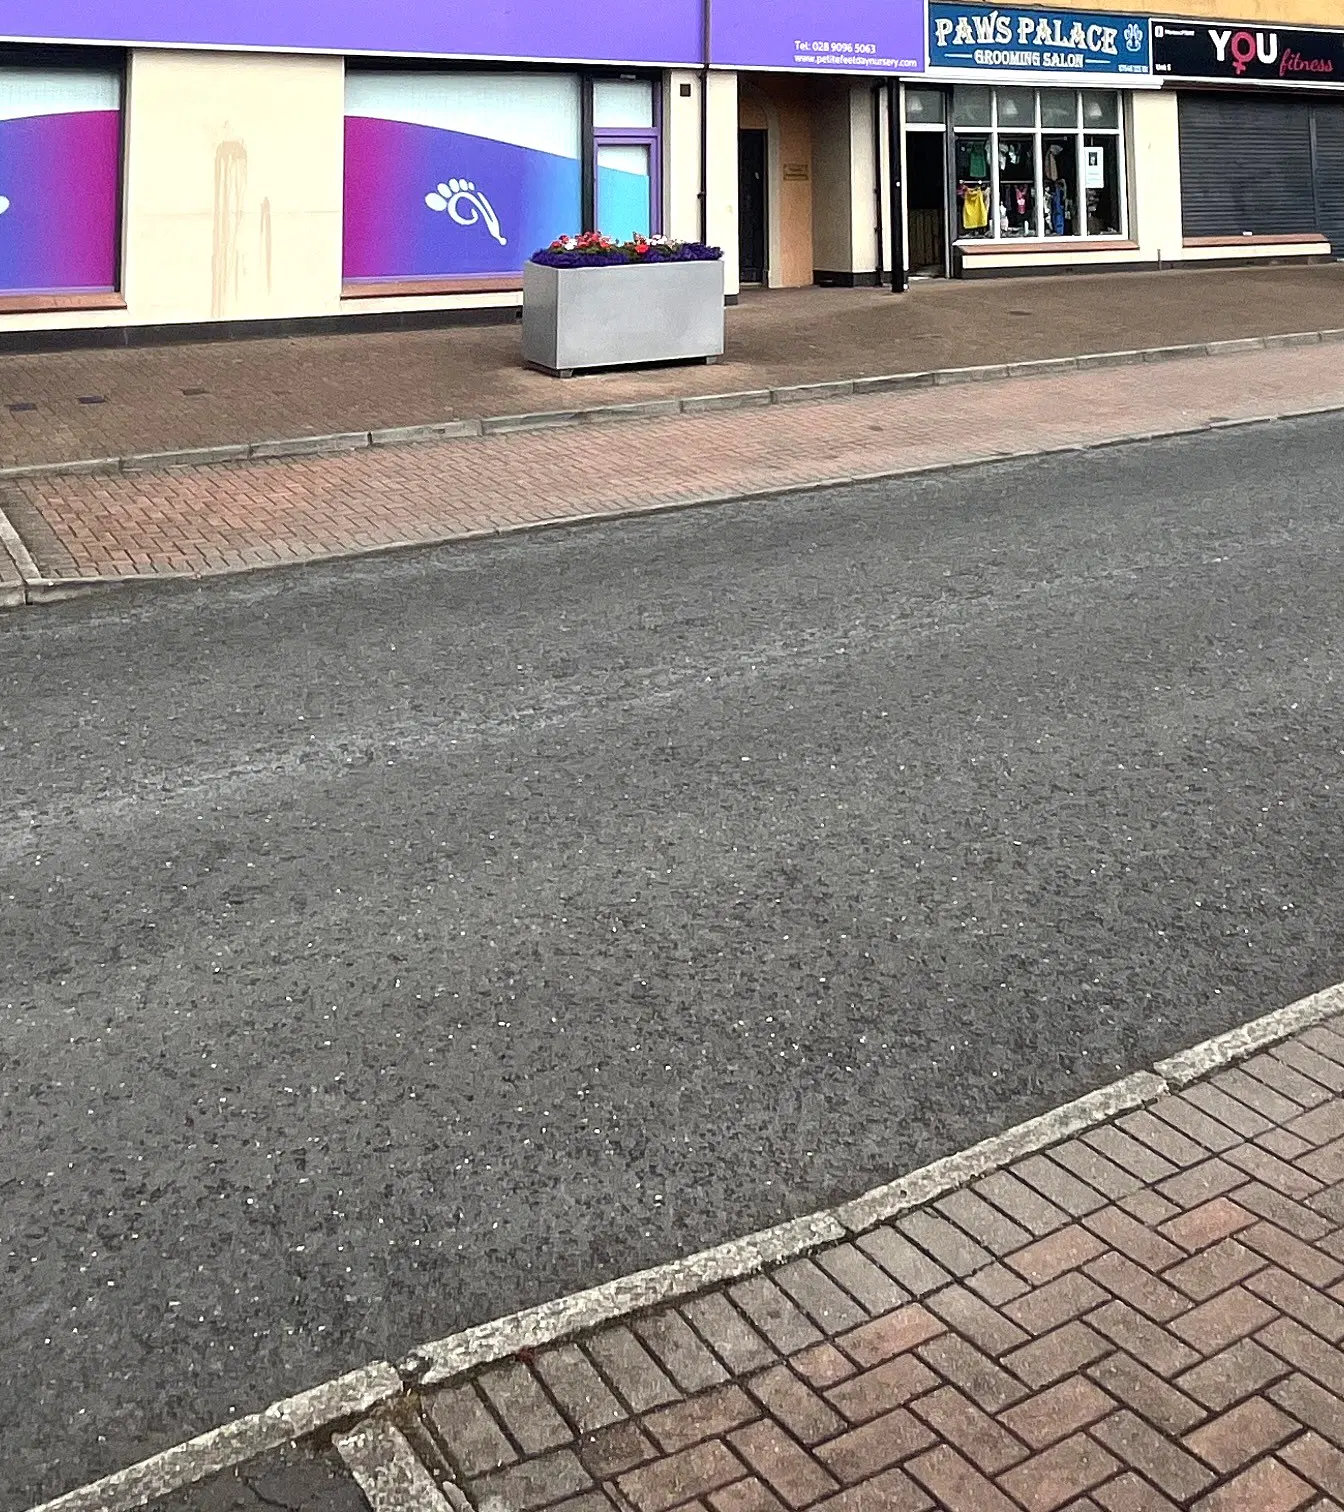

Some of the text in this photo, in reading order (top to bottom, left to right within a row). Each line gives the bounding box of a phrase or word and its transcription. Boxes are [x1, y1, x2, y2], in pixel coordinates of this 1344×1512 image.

[812, 41, 829, 52] 028
[854, 43, 876, 54] 5063
[1017, 16, 1118, 56] PALACE
[973, 49, 1085, 68] GROOMING SALON
[1208, 29, 1334, 77] YOU fitness
